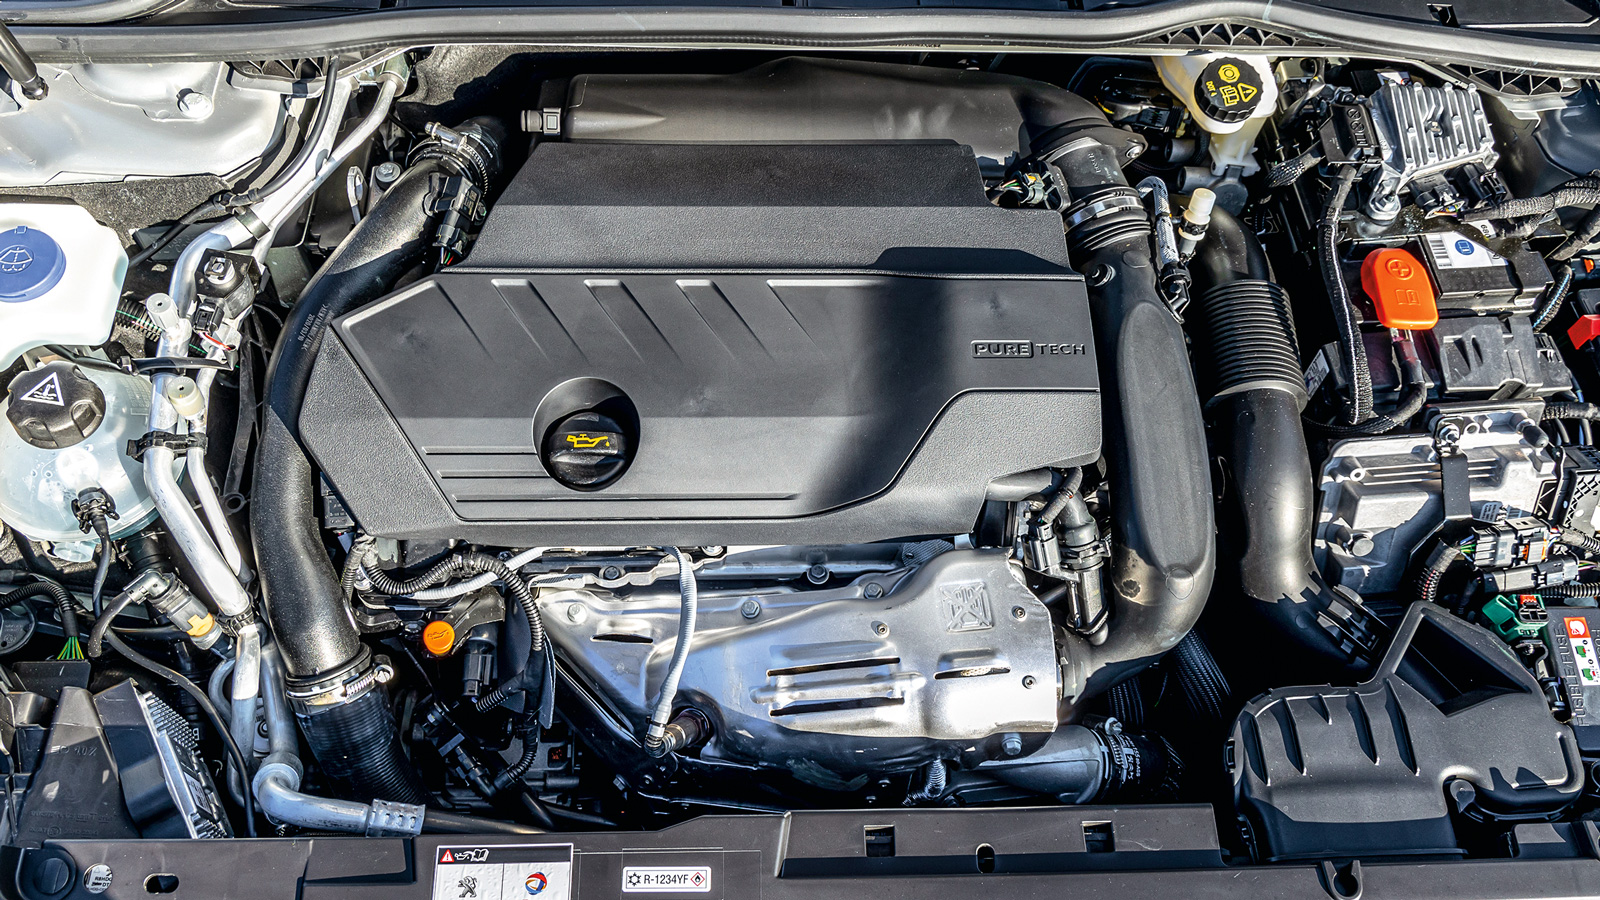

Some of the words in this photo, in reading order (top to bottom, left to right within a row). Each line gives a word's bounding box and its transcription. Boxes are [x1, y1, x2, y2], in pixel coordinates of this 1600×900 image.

[1206, 81, 1216, 91] DOT
[975, 343, 1030, 356] PURE
[1035, 343, 1085, 355] TECH
[643, 874, 688, 885] R-1234YF
